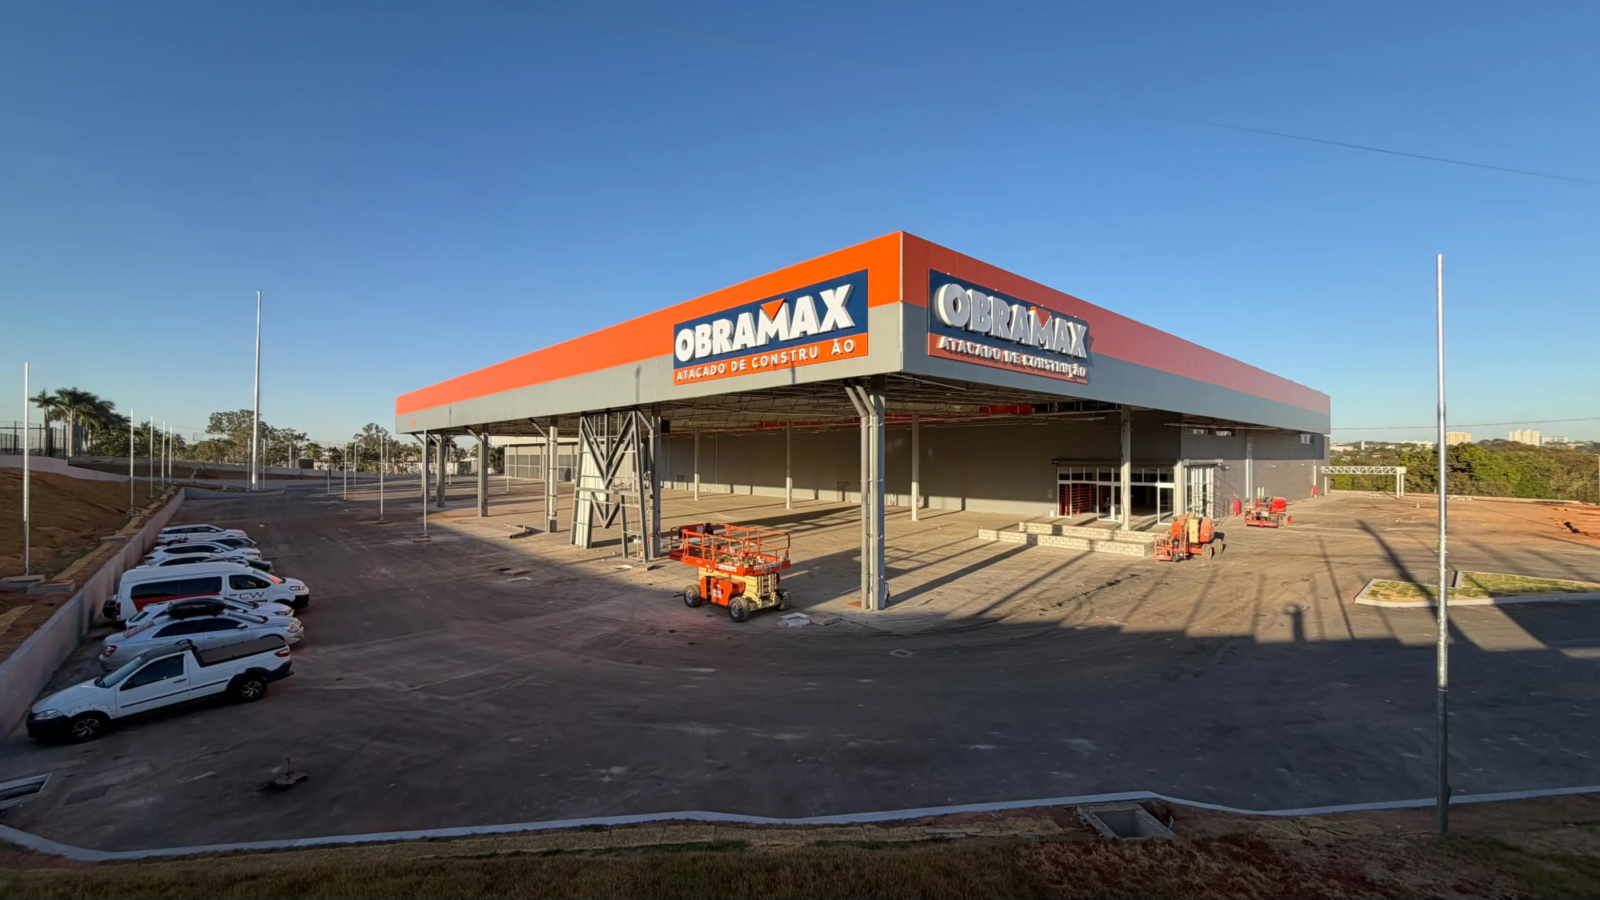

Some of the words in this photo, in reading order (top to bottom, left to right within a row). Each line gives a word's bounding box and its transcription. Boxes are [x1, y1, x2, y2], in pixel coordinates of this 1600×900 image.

[675, 284, 855, 362] OBRAMAX
[935, 283, 1088, 358] OBRAMAX
[677, 363, 726, 381] ATACADO
[731, 359, 747, 372] DE
[939, 335, 1001, 360] ATACADO
[1003, 350, 1020, 363] DE
